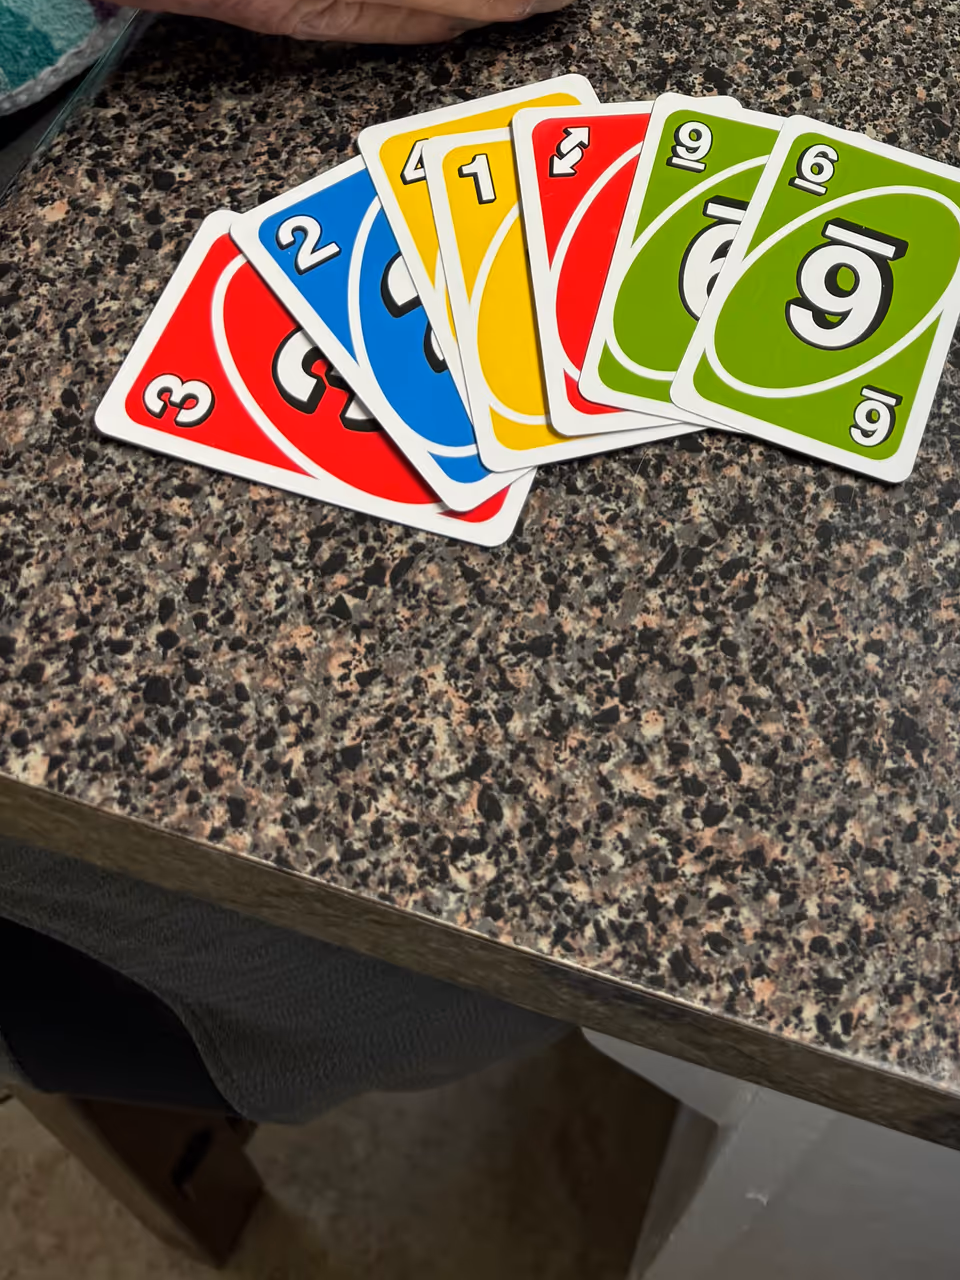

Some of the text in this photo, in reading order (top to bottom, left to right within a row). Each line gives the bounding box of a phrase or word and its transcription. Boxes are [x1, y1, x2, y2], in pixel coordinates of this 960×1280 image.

[458, 153, 497, 204] 1
[789, 143, 839, 196] 6
[275, 214, 342, 276] 2
[142, 372, 216, 429] 3
